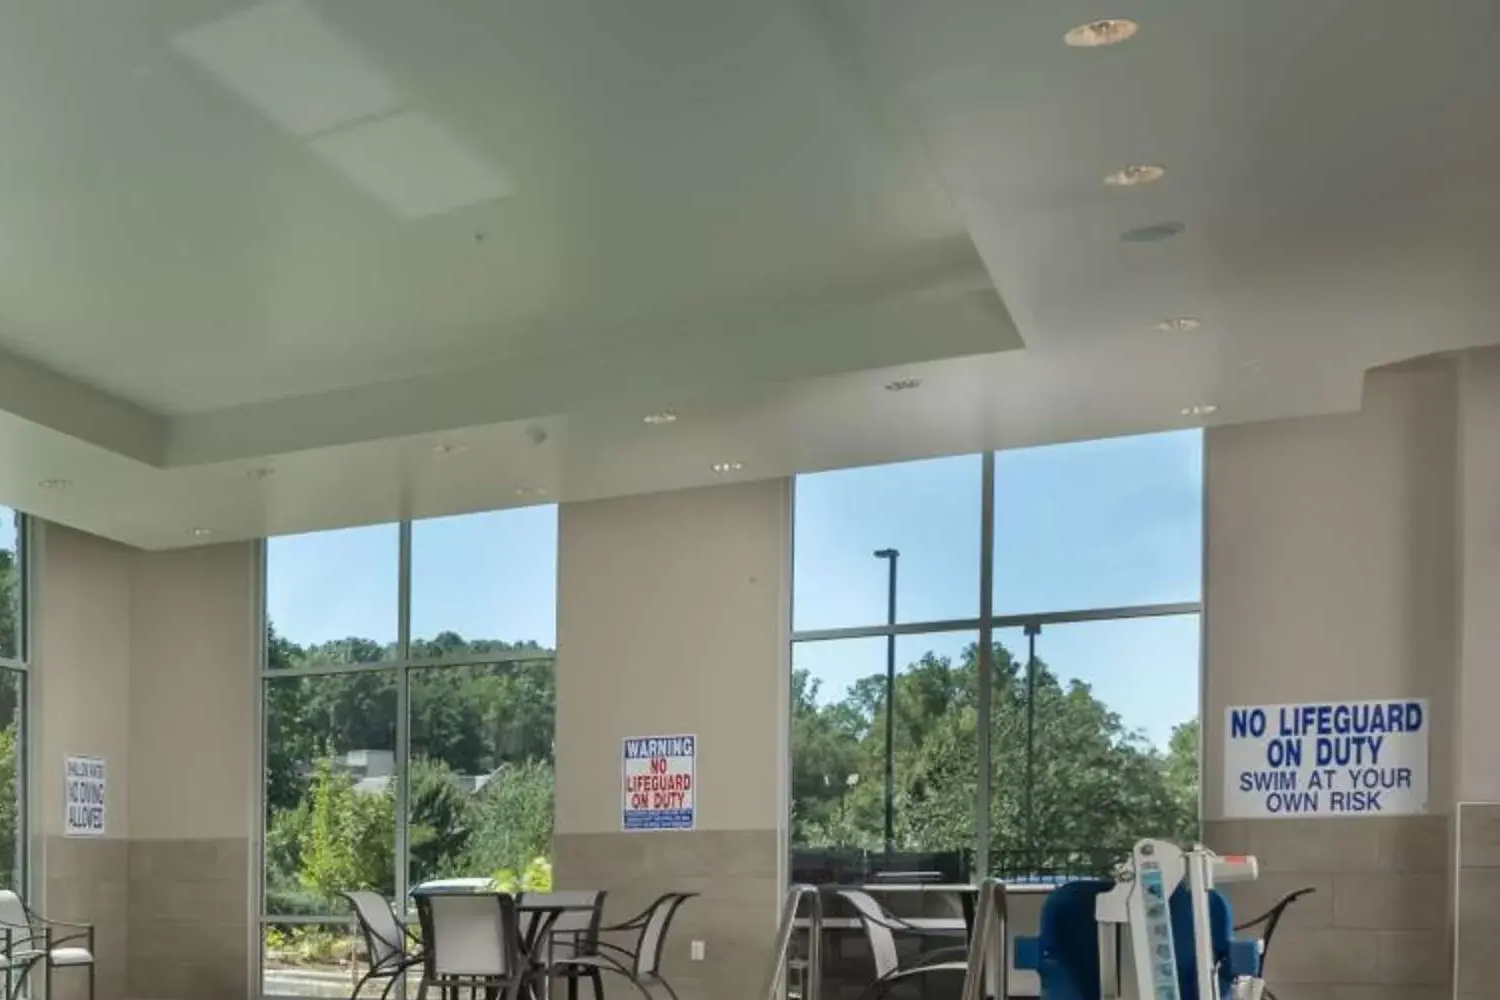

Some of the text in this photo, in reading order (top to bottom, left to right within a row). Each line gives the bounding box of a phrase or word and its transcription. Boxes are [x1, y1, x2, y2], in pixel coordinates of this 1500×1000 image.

[1231, 702, 1423, 738] NO LIFEGUARD
[626, 737, 693, 757] WARNING
[1267, 736, 1383, 768] ON DUTY
[650, 757, 668, 774] NO
[626, 773, 691, 792] LIFEGUARD
[1240, 767, 1412, 792] SWIM AT YOUR
[631, 792, 685, 809] ON DUTY
[1266, 791, 1382, 813] OWN RISK
